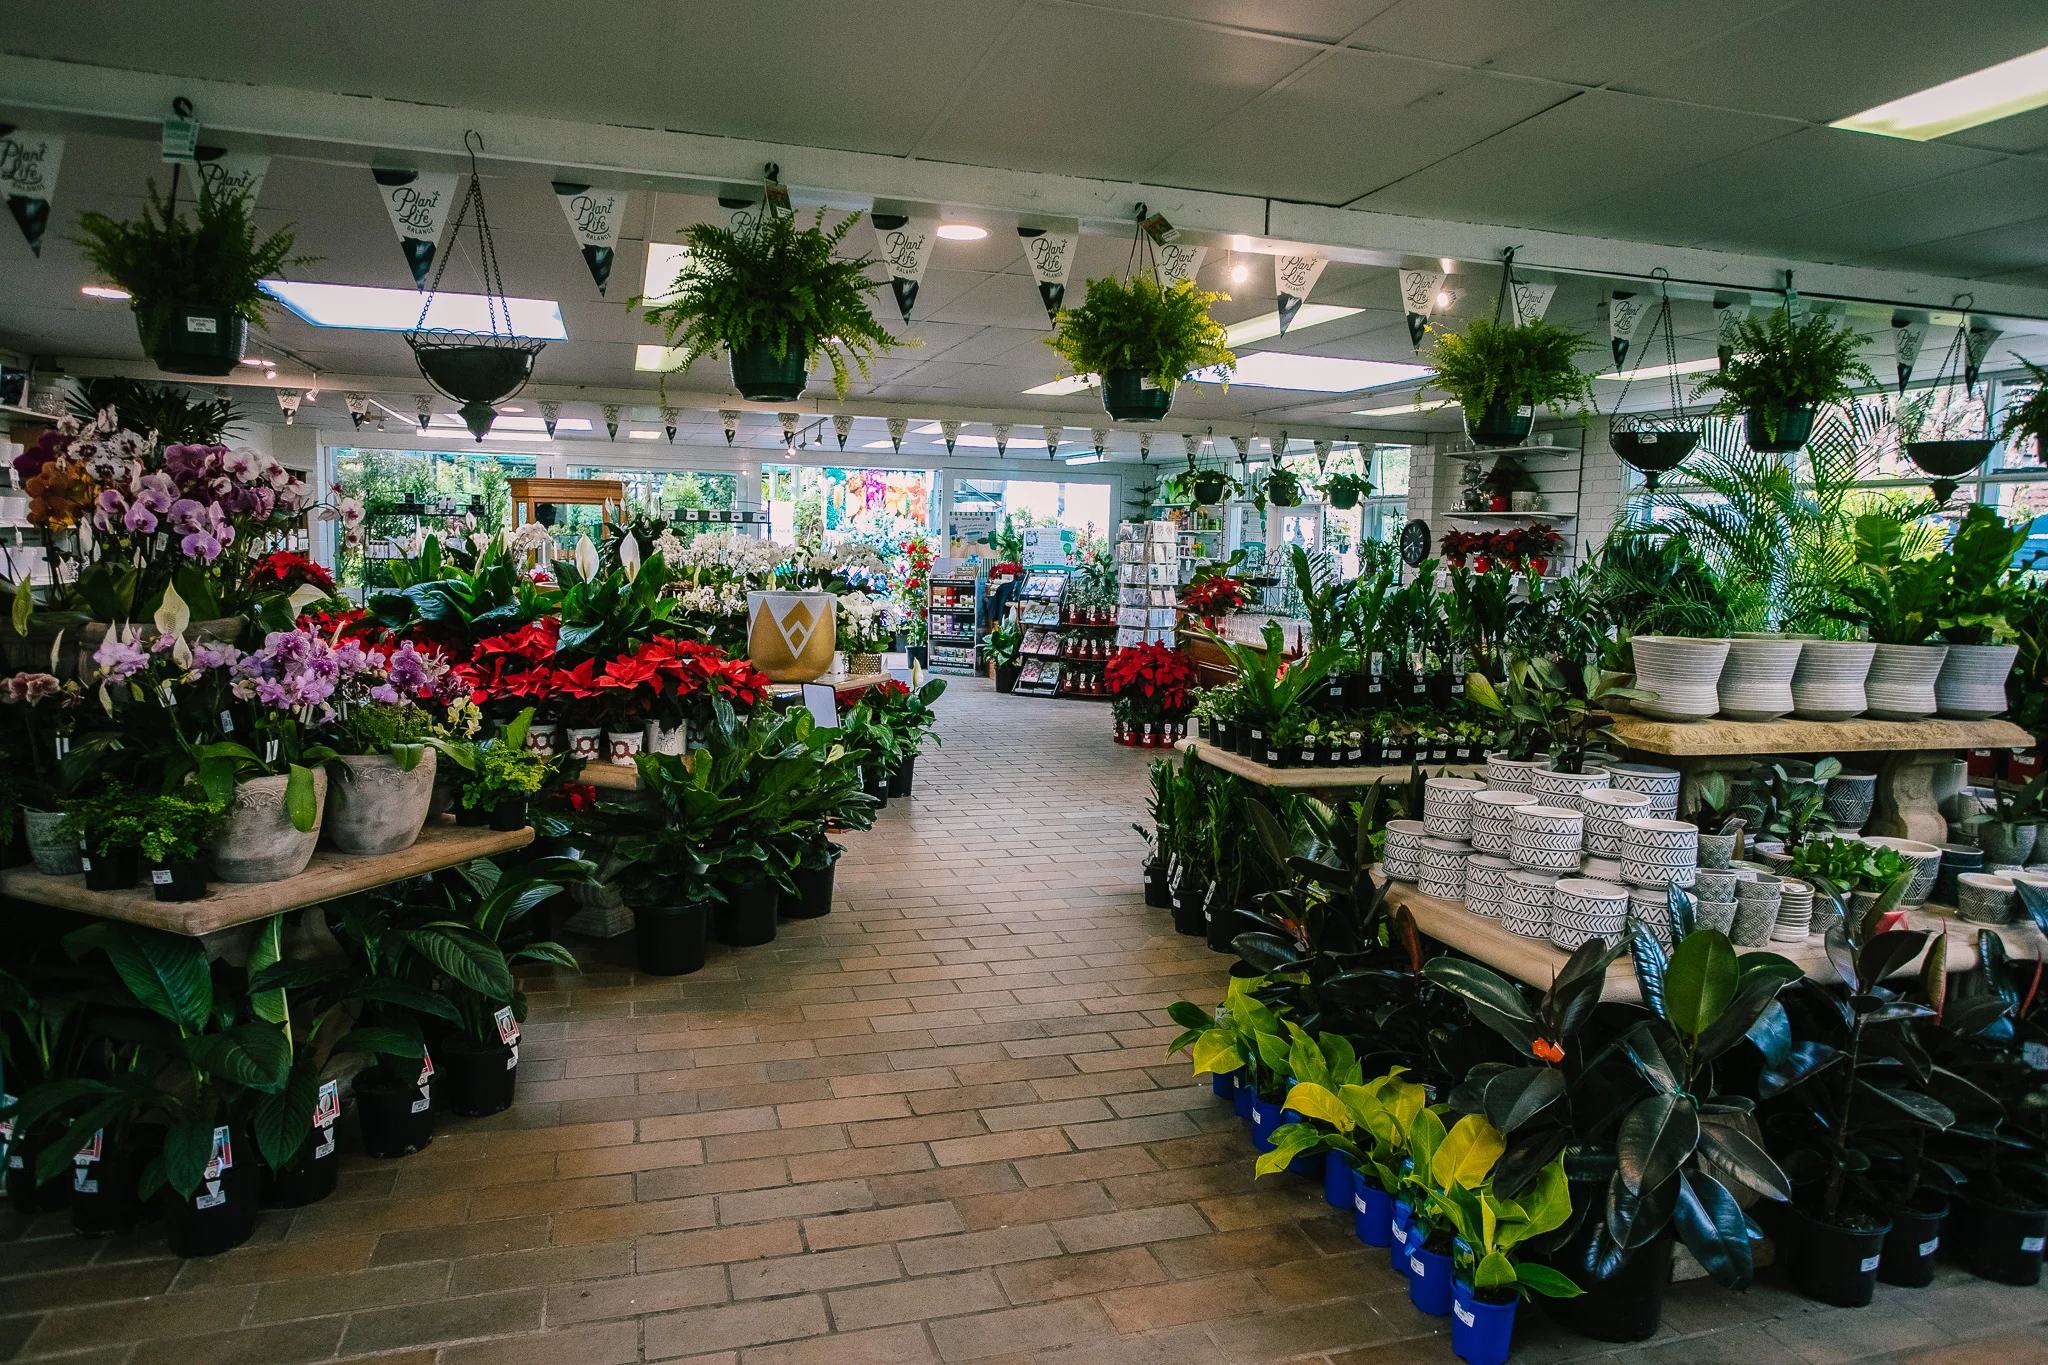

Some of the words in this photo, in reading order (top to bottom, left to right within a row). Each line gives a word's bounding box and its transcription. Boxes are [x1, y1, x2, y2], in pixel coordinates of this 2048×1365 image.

[0, 140, 46, 167] Plant
[2, 161, 42, 184] Life
[198, 163, 249, 188] Plant
[392, 187, 438, 211] Plant
[571, 196, 614, 220] Plant
[399, 209, 433, 228] Life
[579, 215, 610, 234] Life
[406, 225, 435, 235] BALANCE
[585, 232, 611, 242] BALANCE
[886, 231, 923, 254] Plant
[1031, 238, 1066, 261] Plant
[890, 250, 918, 269] Life
[1037, 254, 1062, 272] Life
[1162, 245, 1195, 266] Plant
[1282, 255, 1316, 272] Plant
[895, 266, 918, 275] BALANCE
[1042, 269, 1064, 279] BALANCE
[1164, 260, 1188, 279] Life
[1281, 270, 1306, 287] Life
[1406, 272, 1435, 291] Plant
[1407, 287, 1428, 305] Life
[1517, 286, 1544, 305] Plant
[1519, 301, 1537, 318] Life
[1614, 301, 1642, 318] Plant
[1614, 314, 1632, 331] Life
